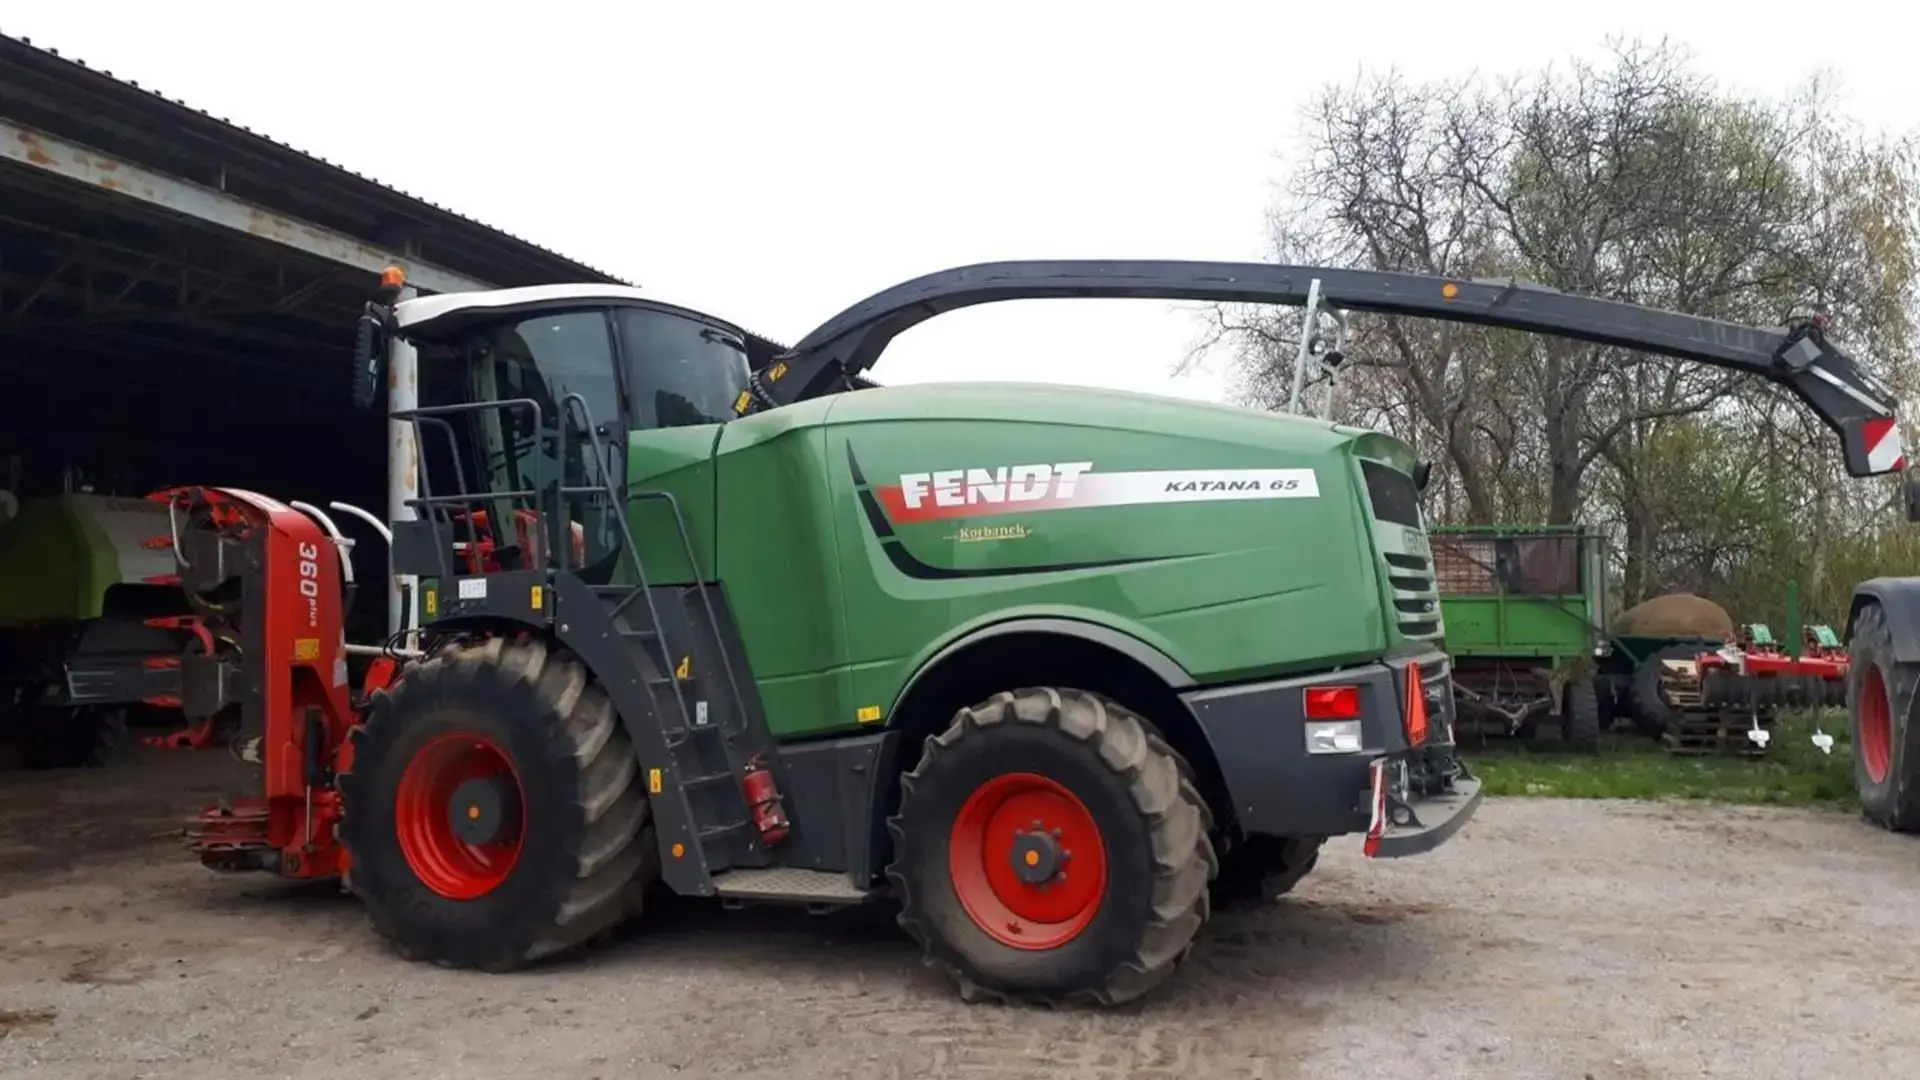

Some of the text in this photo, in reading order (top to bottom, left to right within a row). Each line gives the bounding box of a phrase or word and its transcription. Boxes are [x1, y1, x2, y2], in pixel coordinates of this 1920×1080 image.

[899, 461, 1093, 509] FENDT
[1165, 479, 1299, 492] KATANA 65
[299, 541, 318, 627] 360 plus
